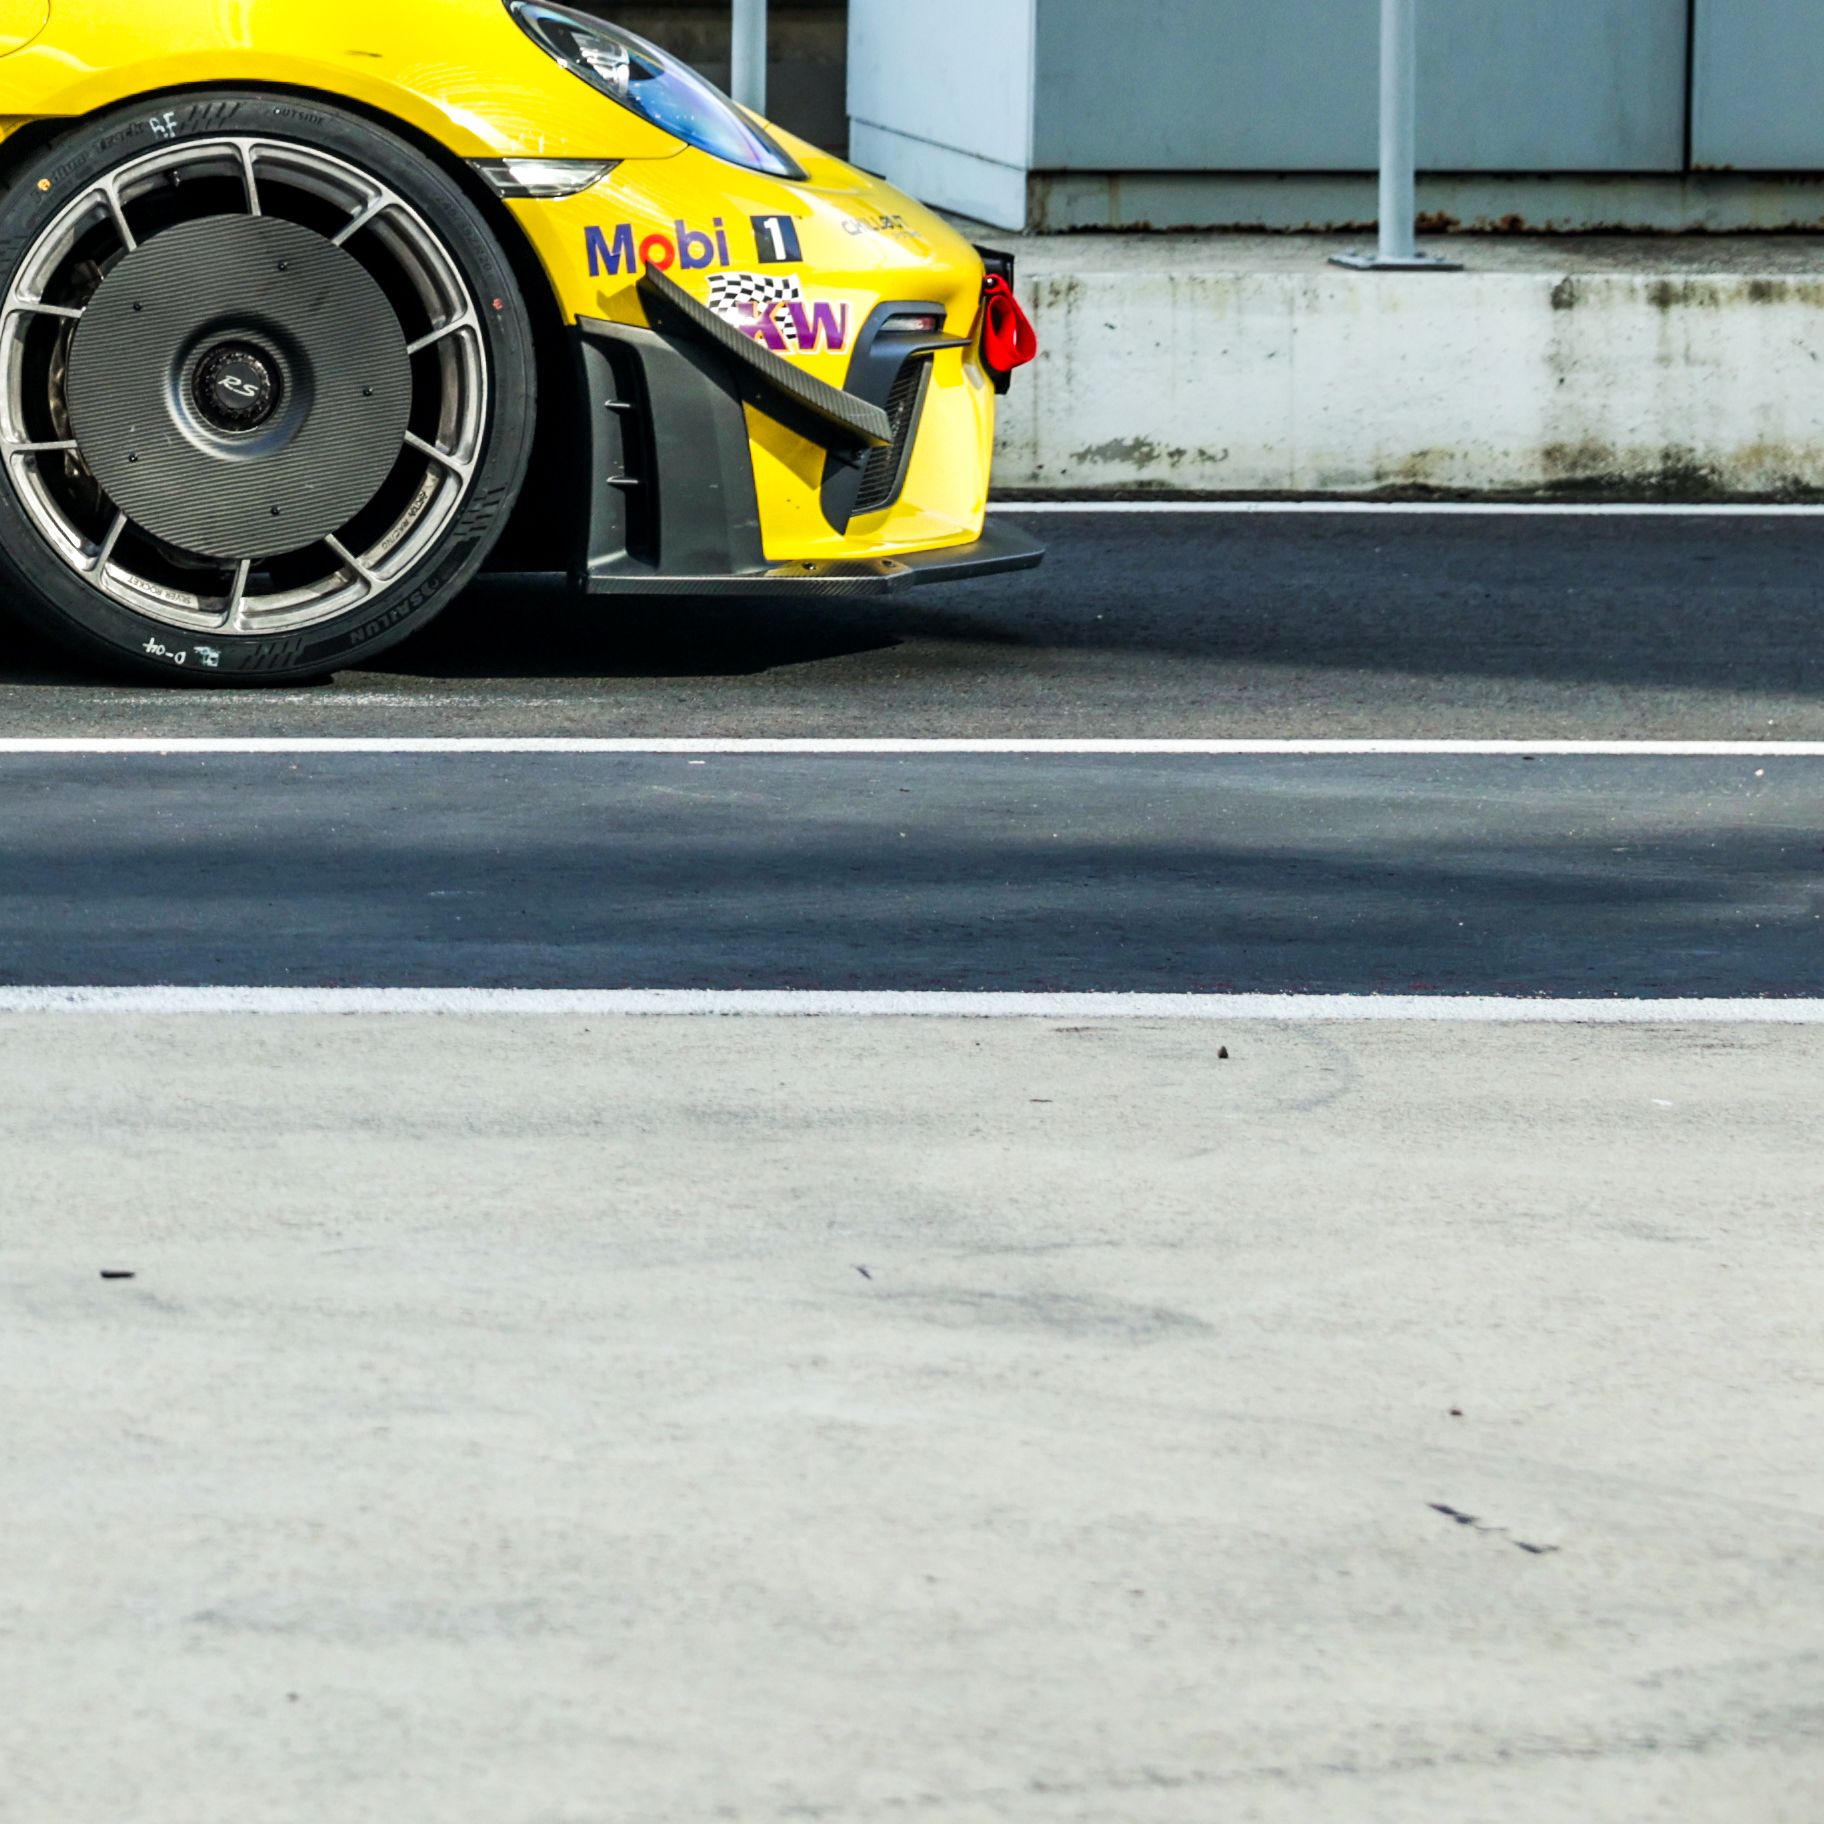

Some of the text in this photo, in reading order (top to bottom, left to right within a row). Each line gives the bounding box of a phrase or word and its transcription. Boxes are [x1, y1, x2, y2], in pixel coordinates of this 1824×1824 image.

[736, 301, 849, 353] KW
[218, 375, 260, 397] RS
[350, 590, 423, 644] SAILUN
